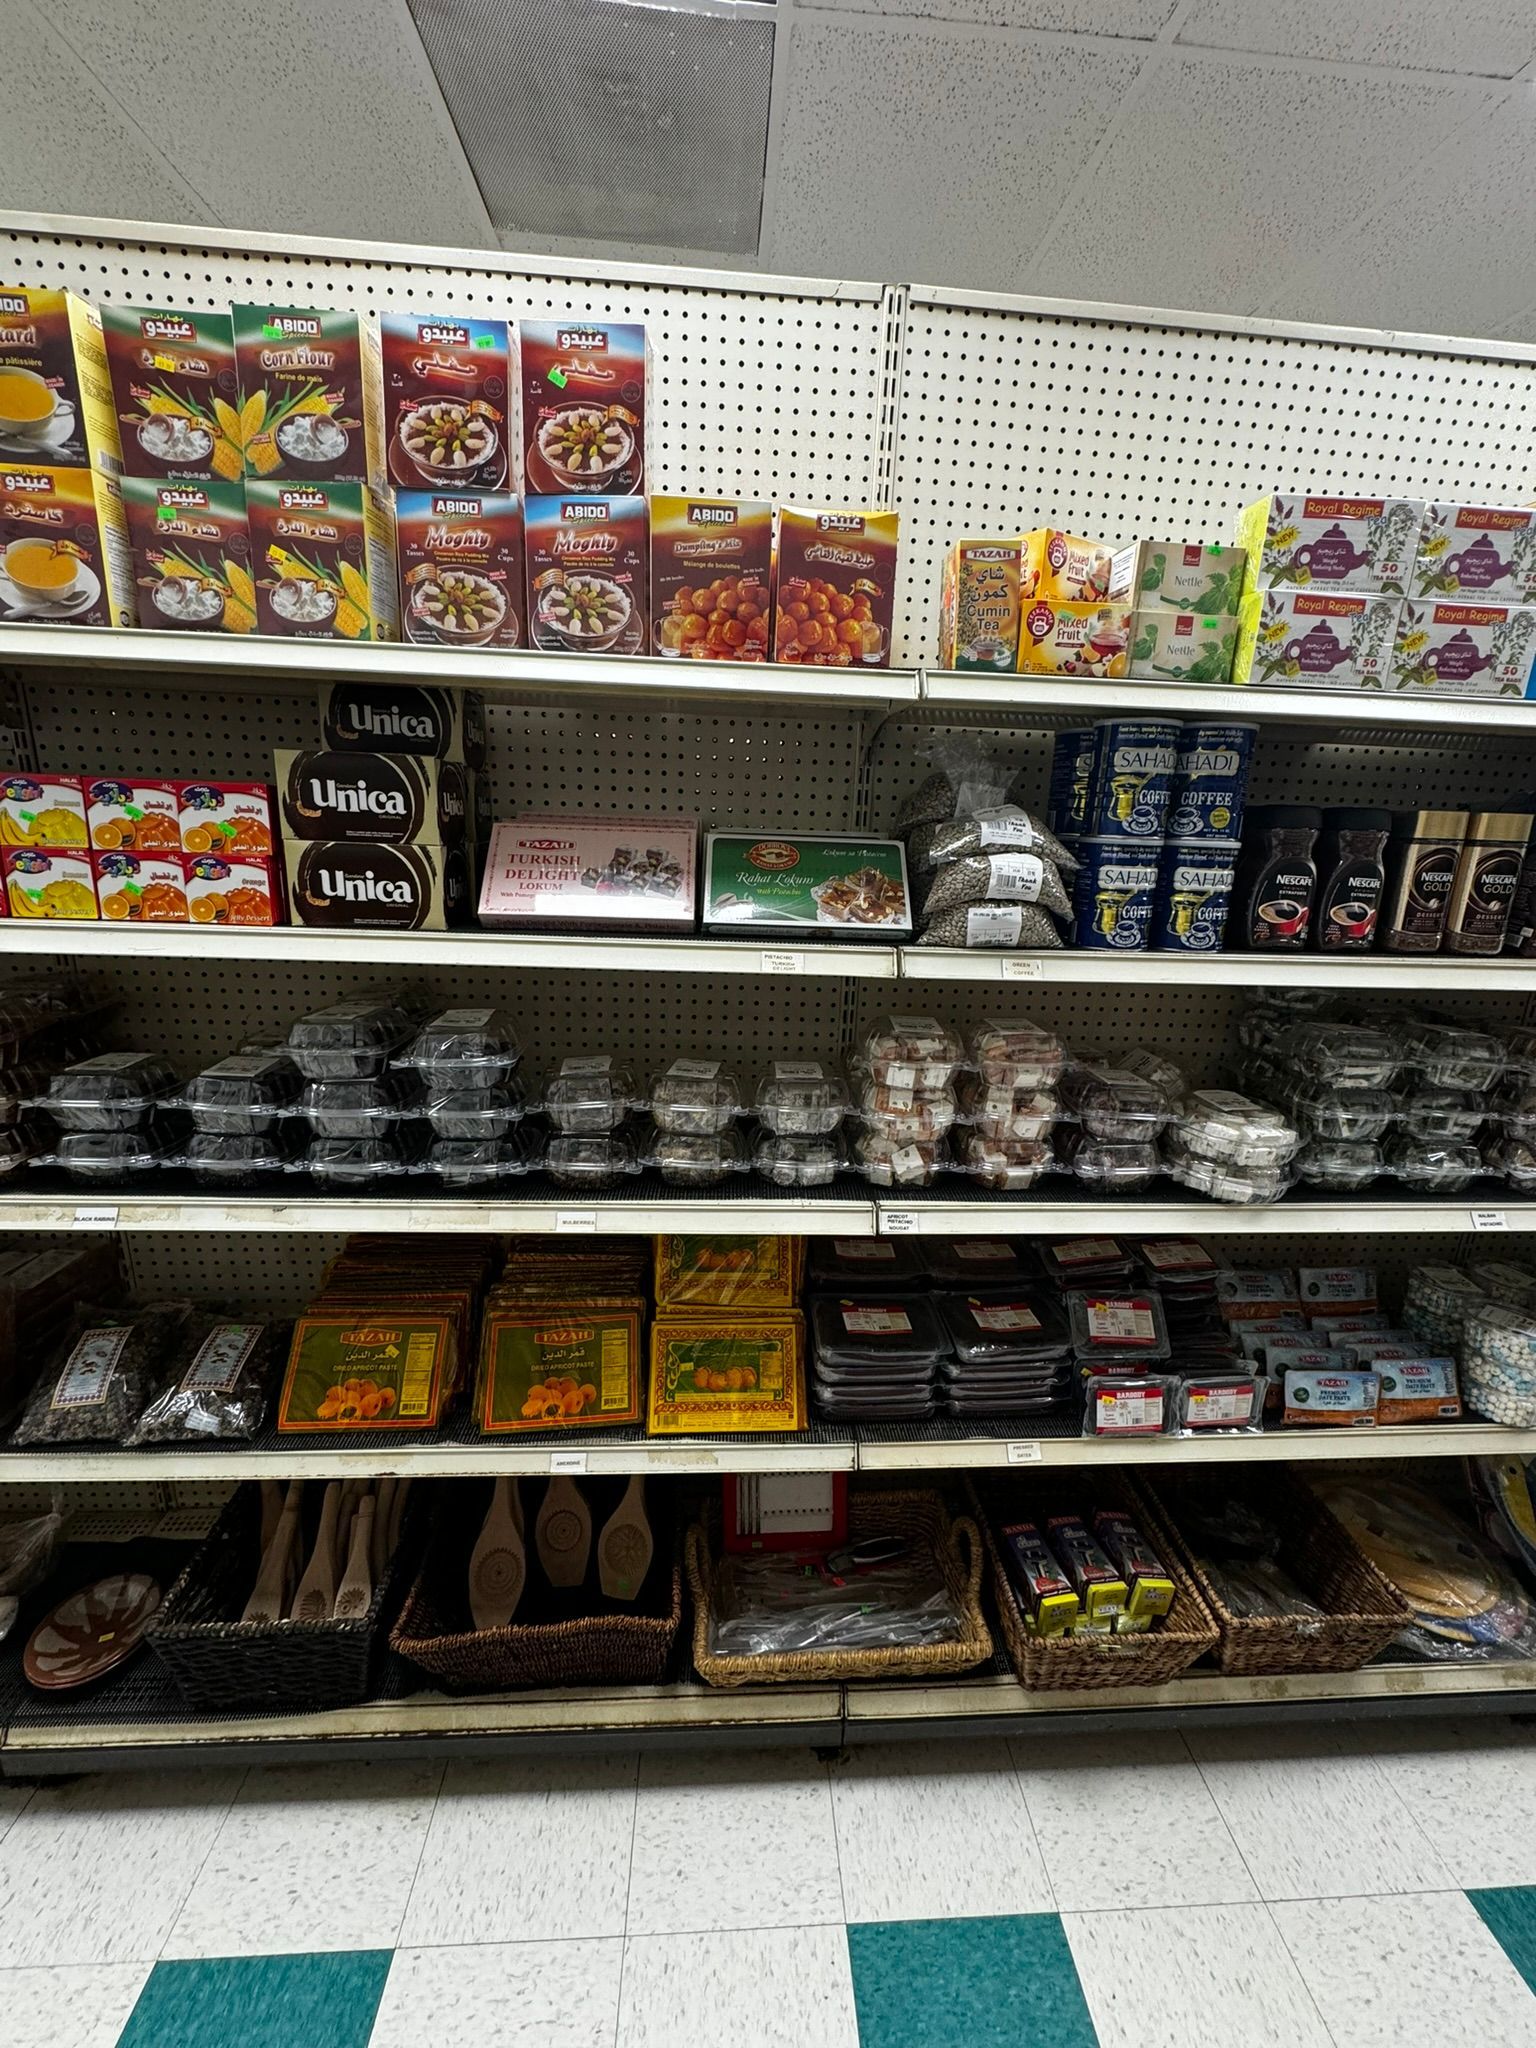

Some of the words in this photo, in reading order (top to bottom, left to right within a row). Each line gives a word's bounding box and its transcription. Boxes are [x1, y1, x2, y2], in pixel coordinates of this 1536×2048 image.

[260, 350, 294, 368] Corn
[297, 351, 333, 370] Flour
[435, 500, 479, 515] ABIDO
[565, 505, 607, 519] ABIDO
[1307, 501, 1339, 516] Royal
[1341, 504, 1382, 519] Regime
[691, 508, 735, 524] ABIDO
[1366, 514, 1387, 527] Tea
[1459, 512, 1488, 526] Royal
[1490, 514, 1529, 528] Regime
[426, 524, 492, 550] Moghly
[553, 529, 619, 554] Moghly
[1274, 530, 1296, 546] NEW
[1428, 538, 1447, 553] NEW
[971, 550, 1014, 560] TAZAH
[975, 565, 1005, 582] شاي
[1380, 563, 1399, 573] 50
[1174, 575, 1204, 588] Nettle
[971, 584, 1009, 602] كمون
[967, 604, 1011, 618] Cumin
[1297, 598, 1324, 612] Royal
[1328, 601, 1364, 614] Regime
[1057, 617, 1088, 629] Mixed
[1437, 609, 1466, 622] Royal
[1469, 610, 1506, 623] Regime
[978, 618, 1000, 631] Tea
[1268, 624, 1286, 638] NEW
[1406, 634, 1424, 649] NEW
[1166, 644, 1196, 657] Nettle
[1363, 658, 1377, 668] 50
[1502, 666, 1518, 675] 50
[349, 704, 436, 738] Unica
[1178, 754, 1233, 771] AHADI
[310, 778, 407, 816] Unica
[1181, 791, 1233, 806] COFFEE
[524, 839, 571, 850] TAZAH
[507, 854, 581, 866] TURKISH
[505, 869, 581, 882] DELIGHT
[736, 871, 772, 887] Rahat
[774, 872, 814, 888] Lokum
[318, 869, 414, 904] Unica
[519, 882, 563, 891] LOKUM
[1423, 882, 1451, 892] GOLD
[1483, 884, 1513, 894] GOLD
[349, 1331, 396, 1342] TAZAH
[542, 1330, 589, 1342] TAZAH
[333, 1364, 352, 1372] DRIED
[531, 1364, 550, 1372] DRIED
[550, 1362, 576, 1371] APRICOT
[576, 1361, 595, 1369] PASTE
